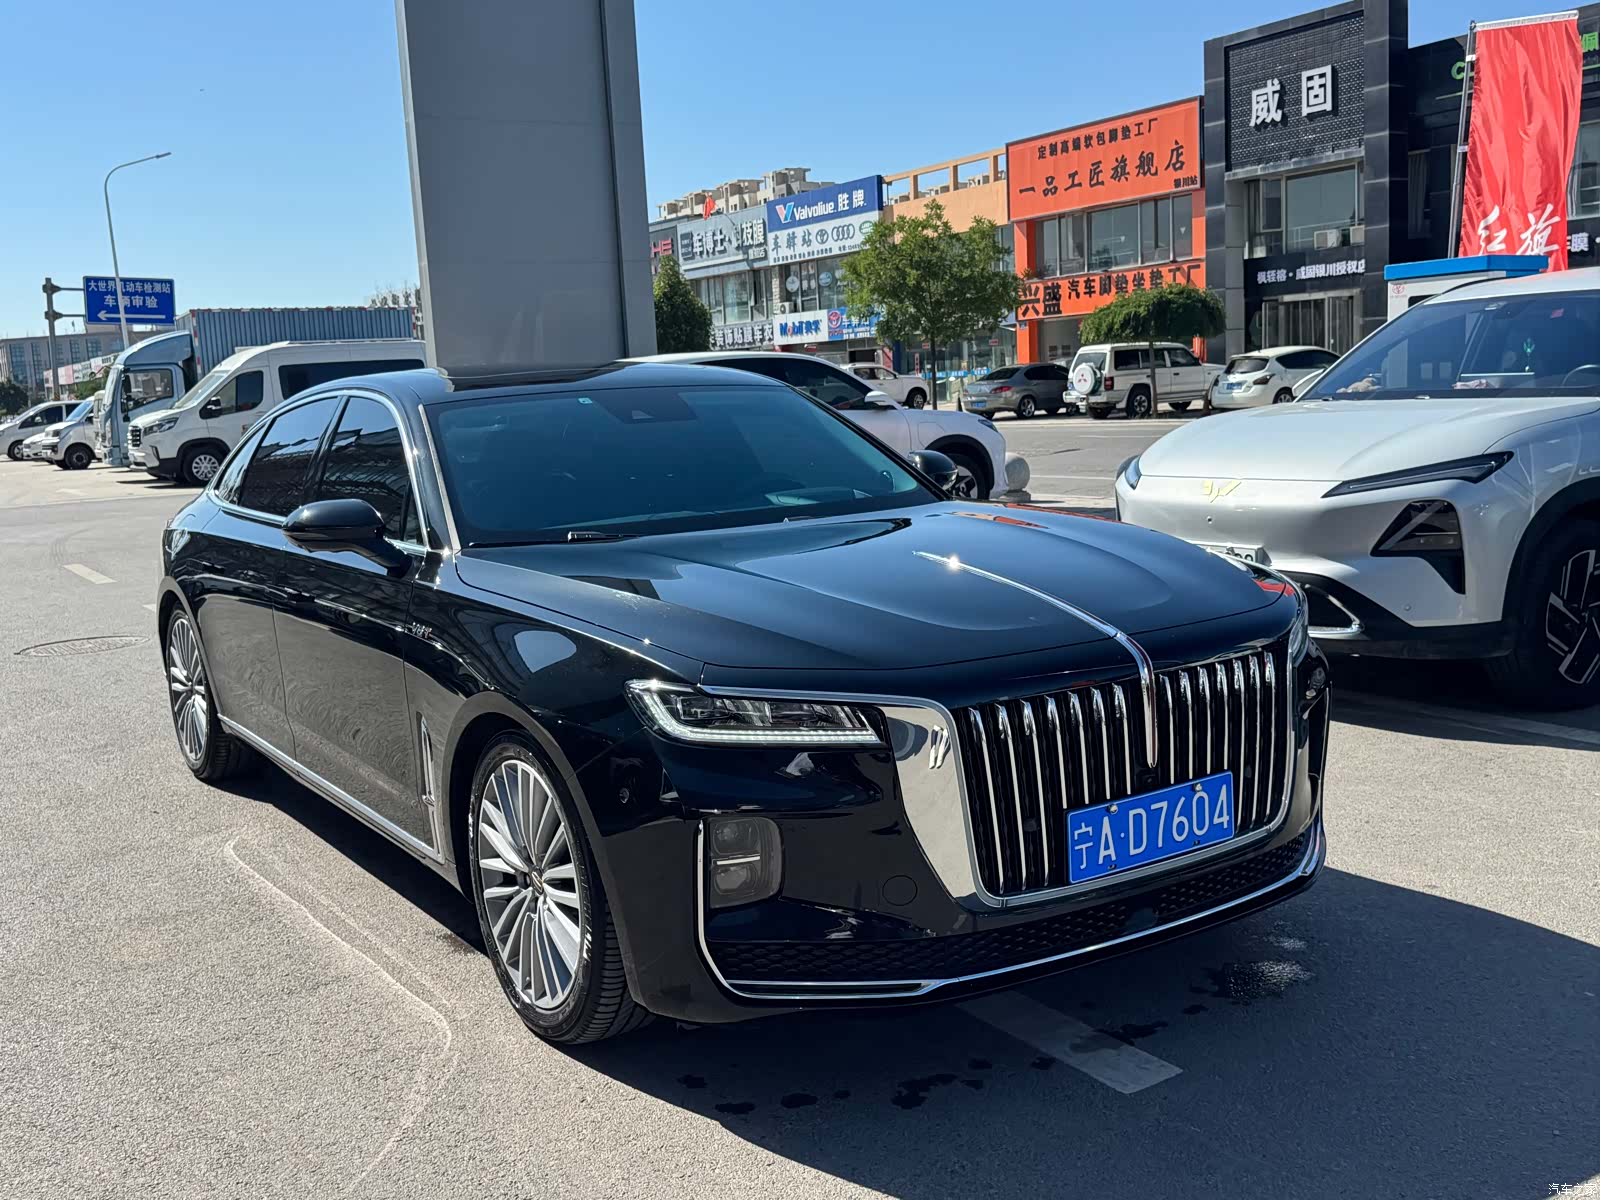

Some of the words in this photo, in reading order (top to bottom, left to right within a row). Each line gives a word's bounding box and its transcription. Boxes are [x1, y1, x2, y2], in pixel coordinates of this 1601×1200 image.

[1249, 64, 1332, 128] 威固
[1037, 118, 1158, 160] 定制高端软包脚垫工厂
[1018, 140, 1186, 197] 一品工匠旗舰店
[837, 189, 865, 211] 胜牌
[1477, 203, 1560, 256] 红旗
[1019, 282, 1062, 317] 兴盛
[1074, 783, 1230, 869] 宁A·D7604
